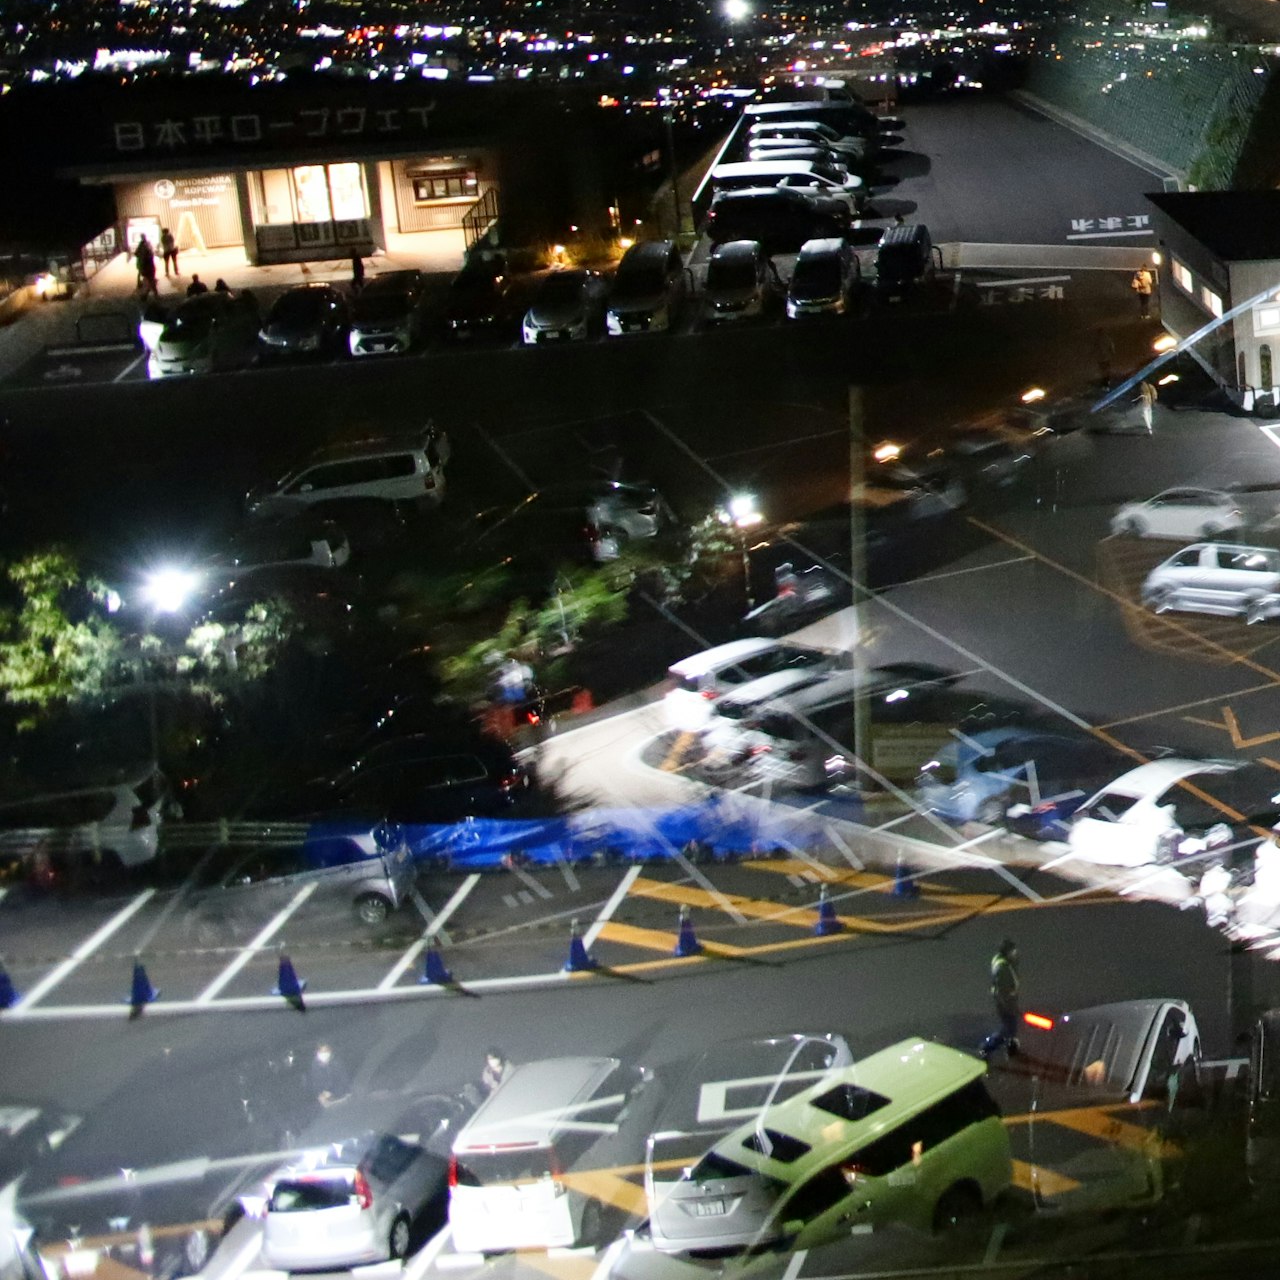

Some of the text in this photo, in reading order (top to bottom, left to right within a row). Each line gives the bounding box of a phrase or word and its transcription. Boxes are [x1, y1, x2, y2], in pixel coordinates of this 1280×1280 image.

[114, 101, 436, 151] 日本平ロープウェイ
